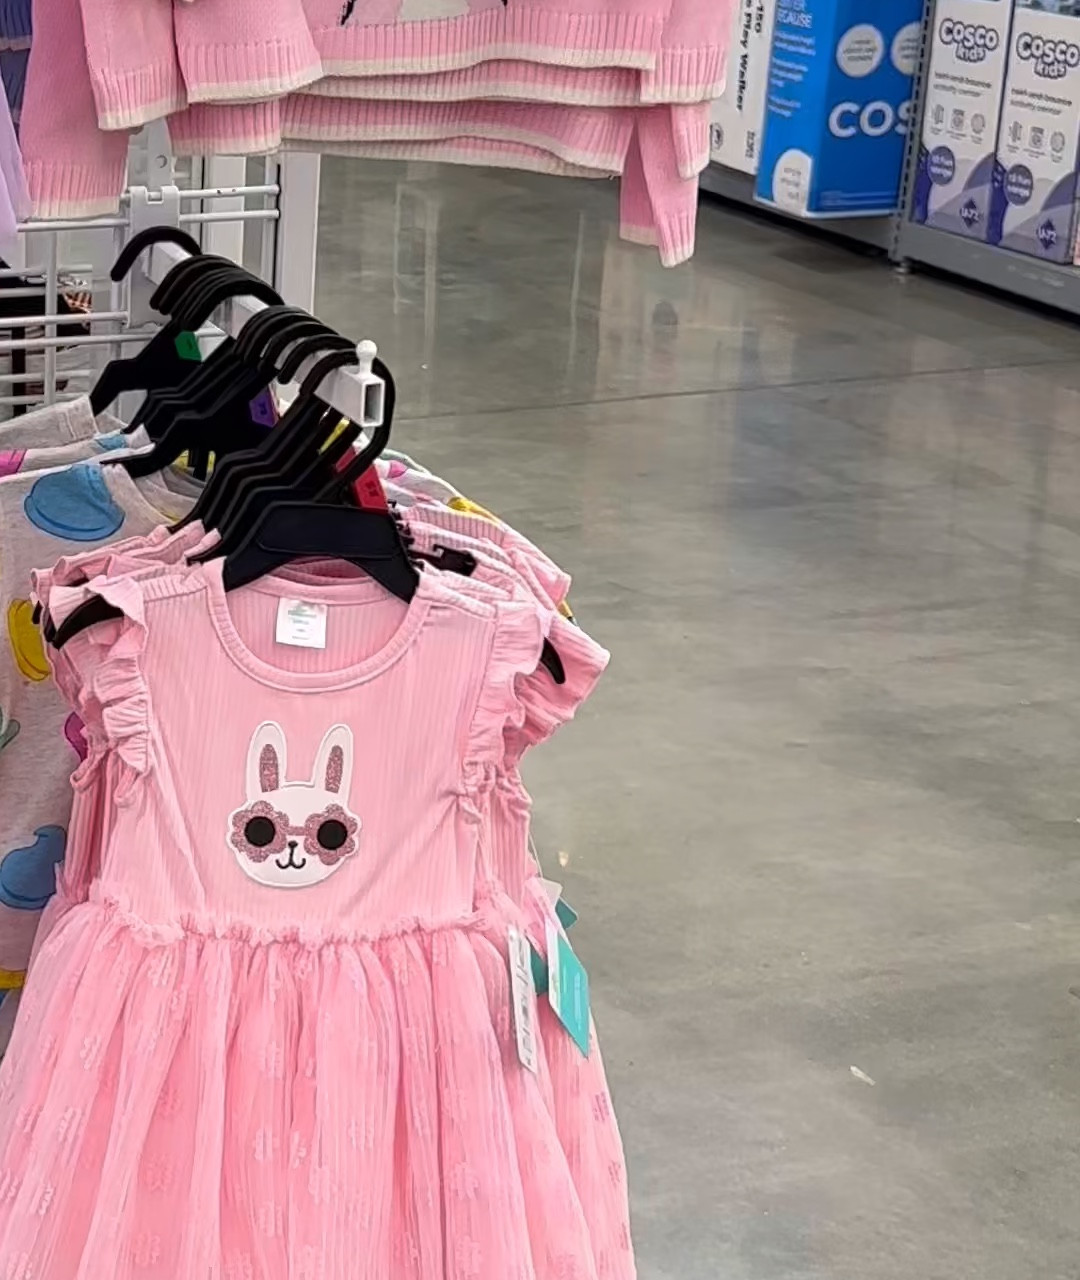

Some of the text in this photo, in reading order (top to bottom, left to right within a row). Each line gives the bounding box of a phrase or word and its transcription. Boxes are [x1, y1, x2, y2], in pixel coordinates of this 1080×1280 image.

[740, 12, 753, 49] Play
[736, 54, 749, 112] Walker
[828, 100, 912, 138] COS
